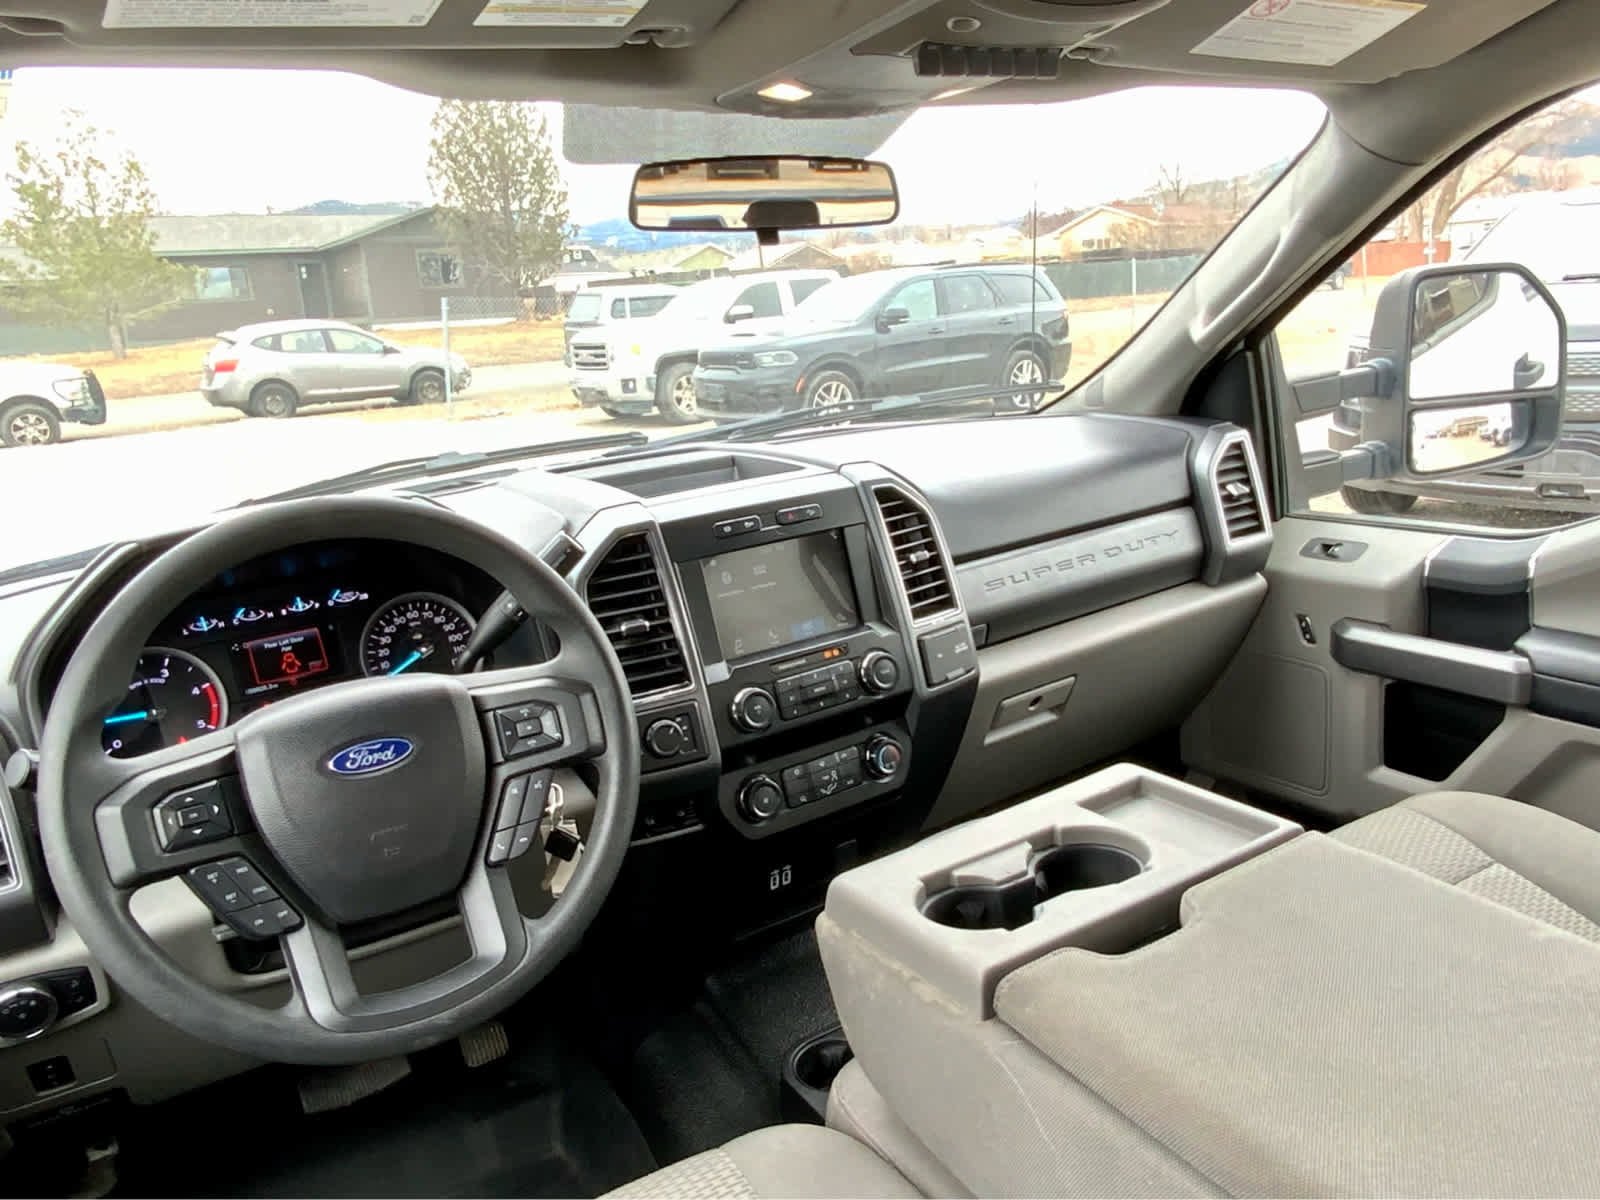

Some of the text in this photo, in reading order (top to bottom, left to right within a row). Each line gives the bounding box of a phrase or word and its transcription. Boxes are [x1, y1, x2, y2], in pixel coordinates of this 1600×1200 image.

[984, 529, 1179, 592] SUPER DUTY
[406, 610, 419, 619] 60
[422, 611, 434, 619] 70
[393, 616, 406, 625] 50
[434, 615, 446, 624] 80
[384, 624, 397, 633] 40
[442, 622, 456, 632] 90
[379, 635, 392, 645] 30
[448, 633, 463, 642] 100
[378, 647, 390, 657] 20
[380, 660, 391, 669] 10
[160, 669, 169, 678] 3
[192, 686, 200, 695] 4
[197, 720, 206, 728] 5
[112, 739, 122, 748] 0
[346, 743, 397, 769] Ford
